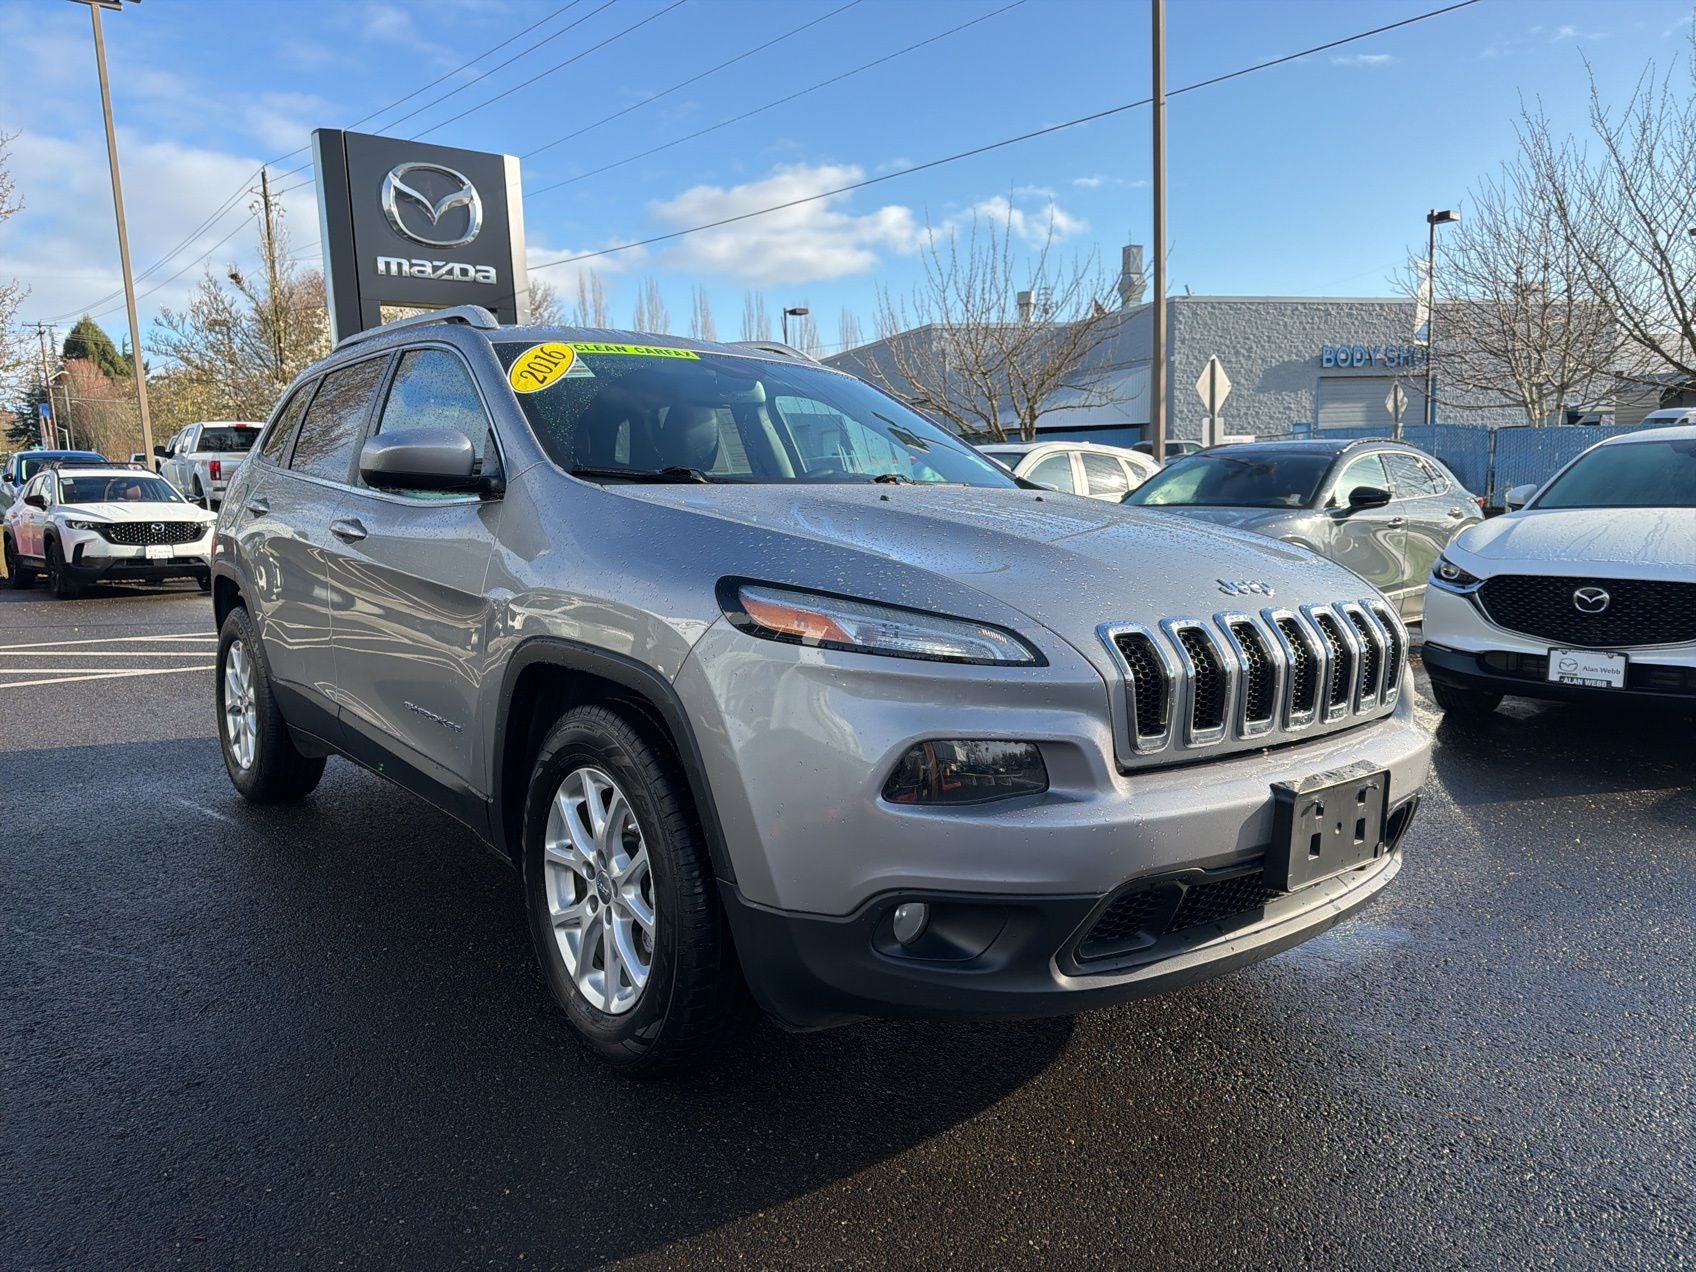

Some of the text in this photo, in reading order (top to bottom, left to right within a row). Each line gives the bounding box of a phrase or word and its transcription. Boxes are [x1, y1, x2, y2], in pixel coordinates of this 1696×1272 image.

[573, 344, 627, 353] CLEAN
[1322, 345, 1379, 368] BODY
[519, 346, 566, 385] 2016
[1216, 578, 1275, 598] Jeep
[1583, 665, 1621, 675] Alan Webb
[1563, 677, 1607, 688] ALAN WEBB
